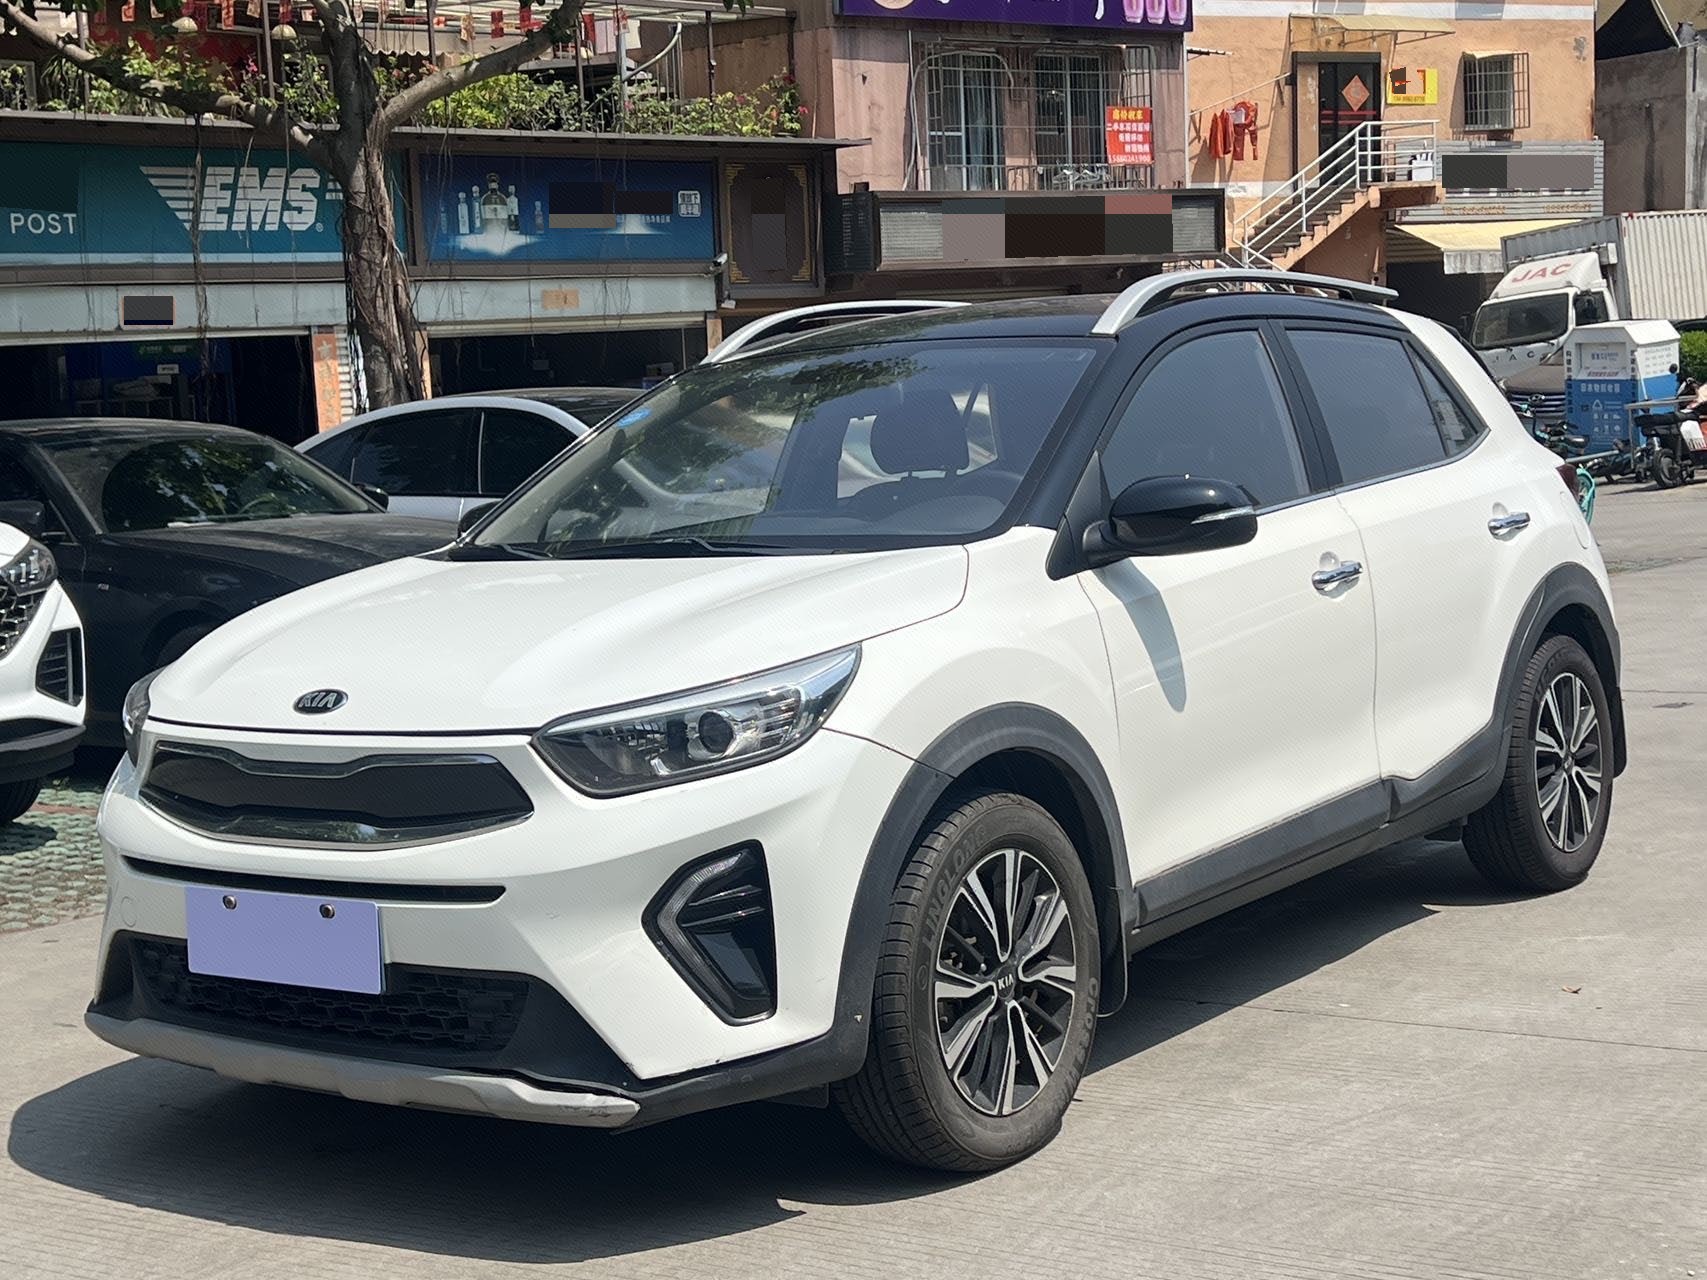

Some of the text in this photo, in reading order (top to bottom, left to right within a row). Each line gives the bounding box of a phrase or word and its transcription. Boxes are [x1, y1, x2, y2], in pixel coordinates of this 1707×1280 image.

[197, 167, 320, 231] EMS
[10, 213, 77, 235] POST
[1511, 263, 1572, 283] JAC
[298, 692, 338, 708] KIA
[998, 973, 1014, 990] KIA
